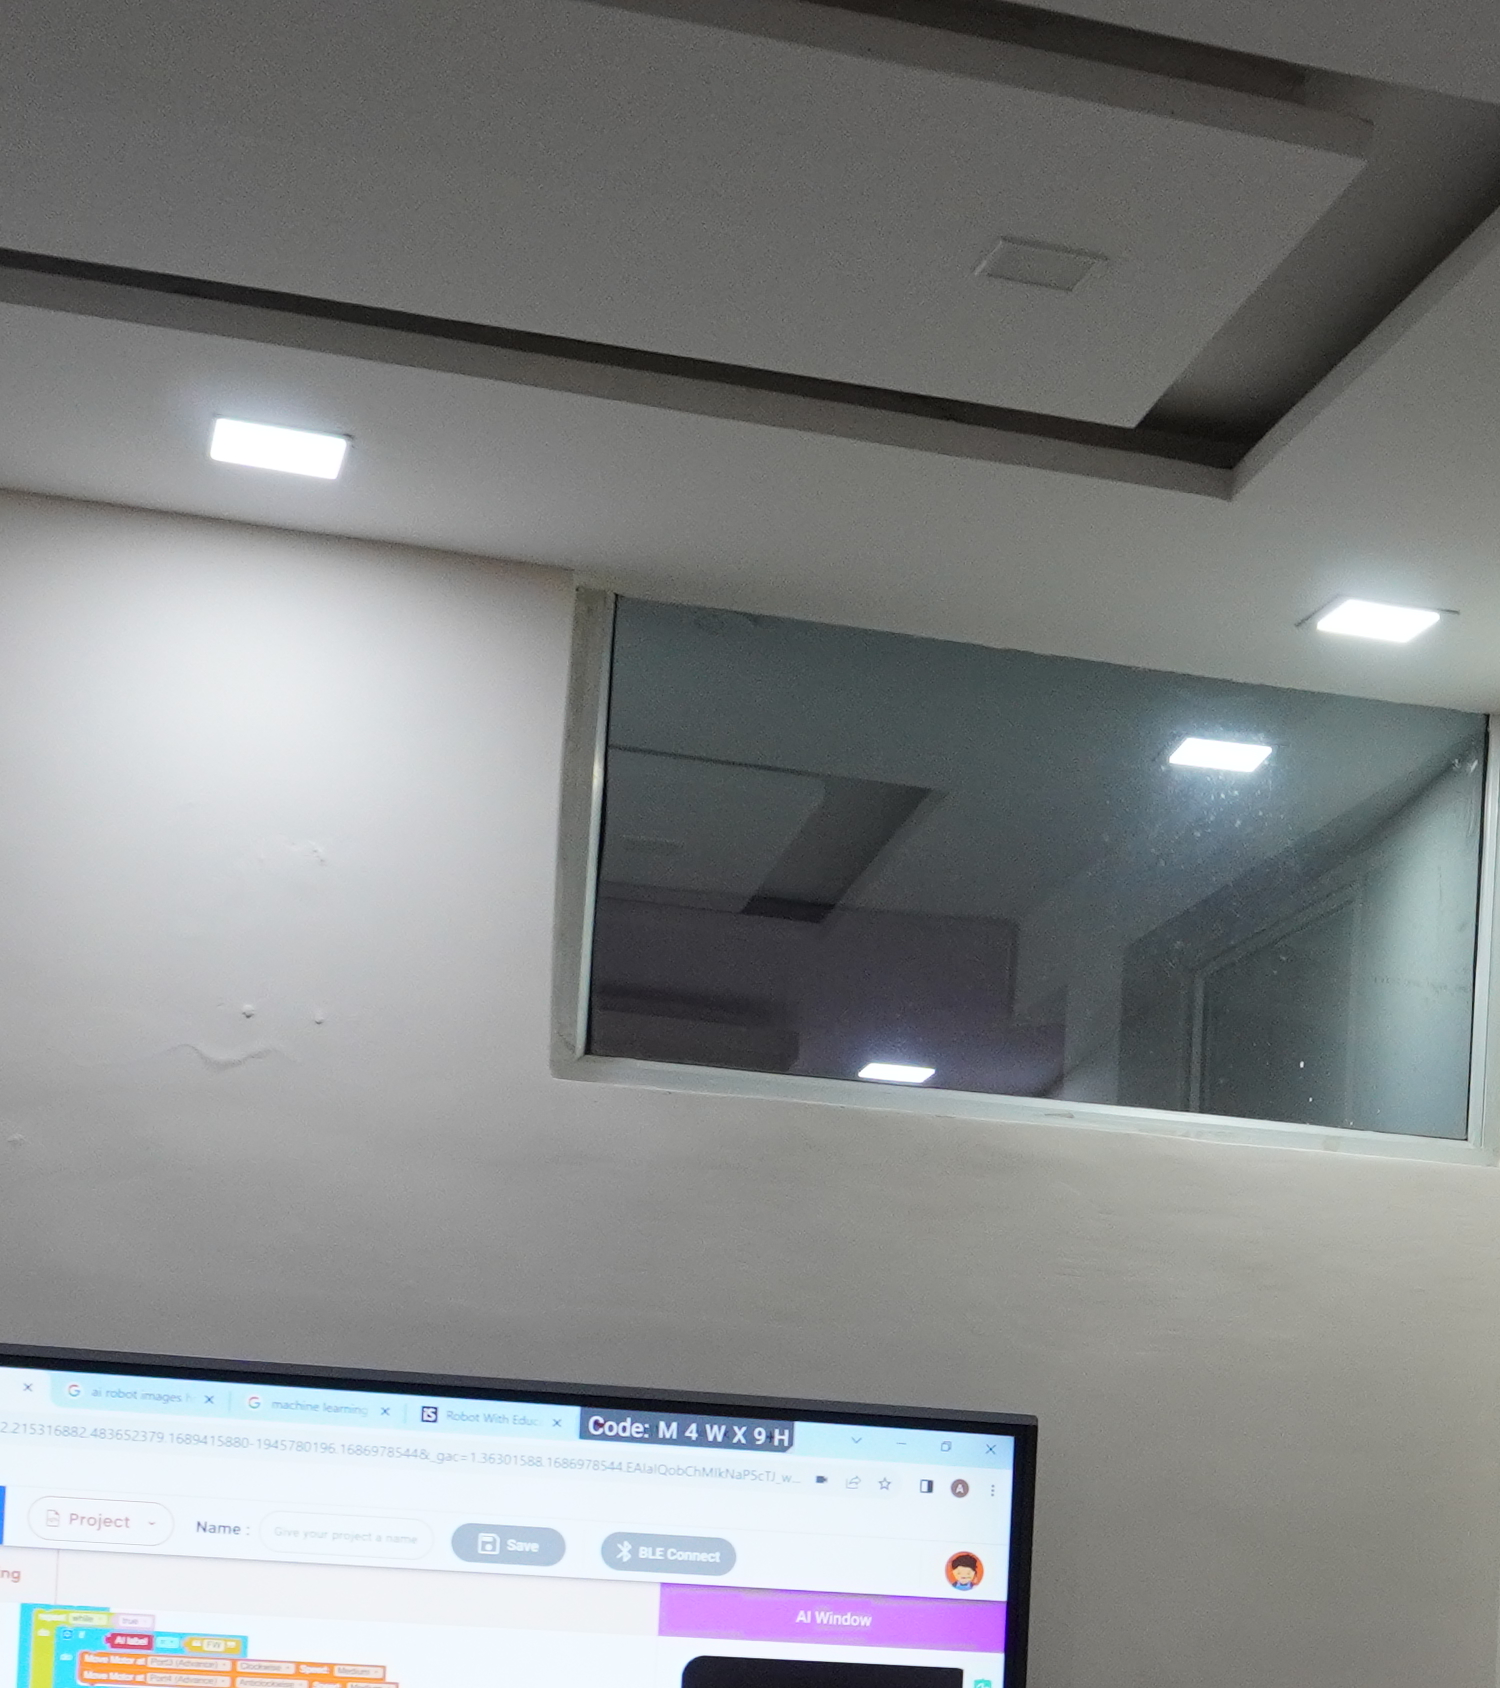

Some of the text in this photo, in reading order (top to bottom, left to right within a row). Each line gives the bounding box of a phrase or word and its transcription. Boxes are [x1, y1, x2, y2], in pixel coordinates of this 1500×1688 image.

[271, 1398, 329, 1413] machine
[446, 1410, 480, 1423] Robot
[482, 1412, 508, 1425] With
[587, 1415, 789, 1447] Code: M 4 W X 9 H
[68, 1512, 130, 1532] Project
[195, 1520, 241, 1535] Name
[506, 1538, 539, 1553] Save
[638, 1546, 721, 1563] BLE Connect
[795, 1609, 871, 1627] AI Window
